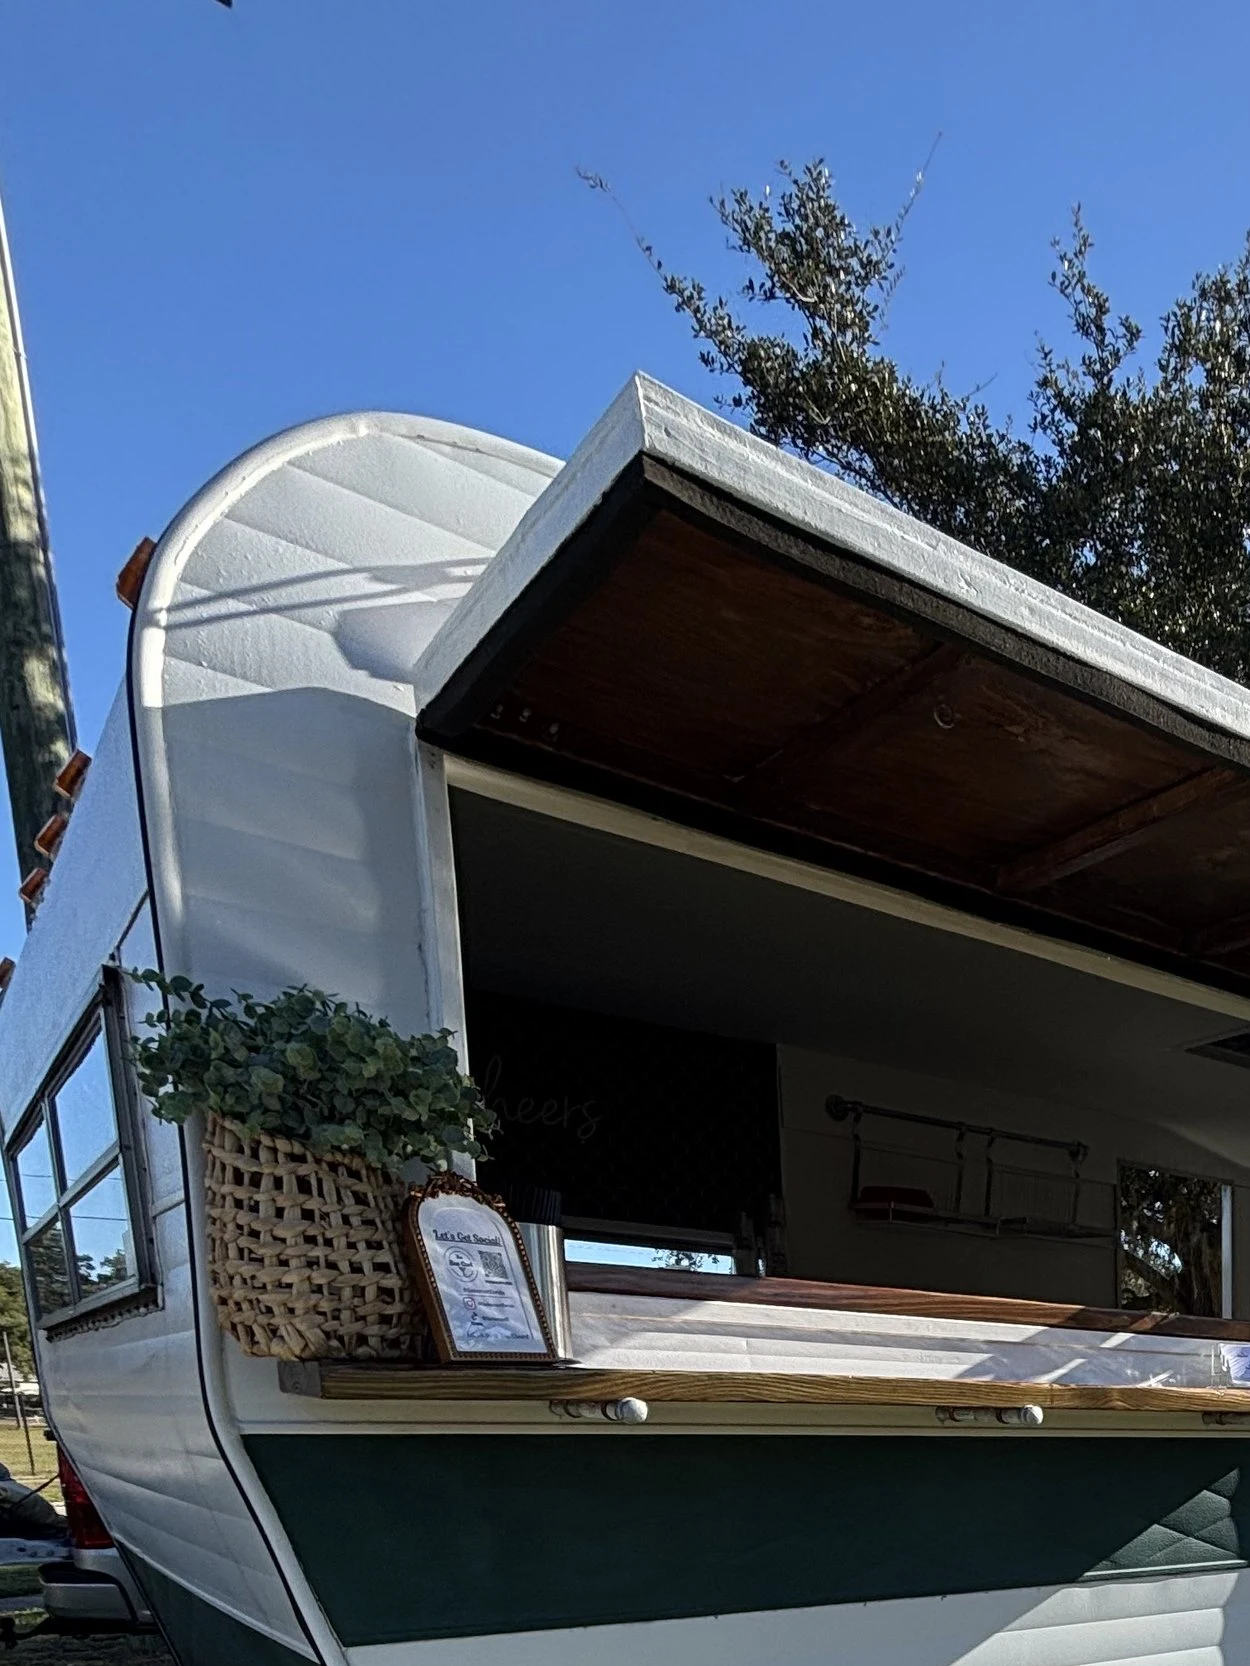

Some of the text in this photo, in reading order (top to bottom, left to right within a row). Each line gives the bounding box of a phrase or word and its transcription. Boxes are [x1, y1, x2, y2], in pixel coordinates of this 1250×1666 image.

[483, 1053, 604, 1141] heers
[432, 1229, 502, 1245] Let's Get Social!
